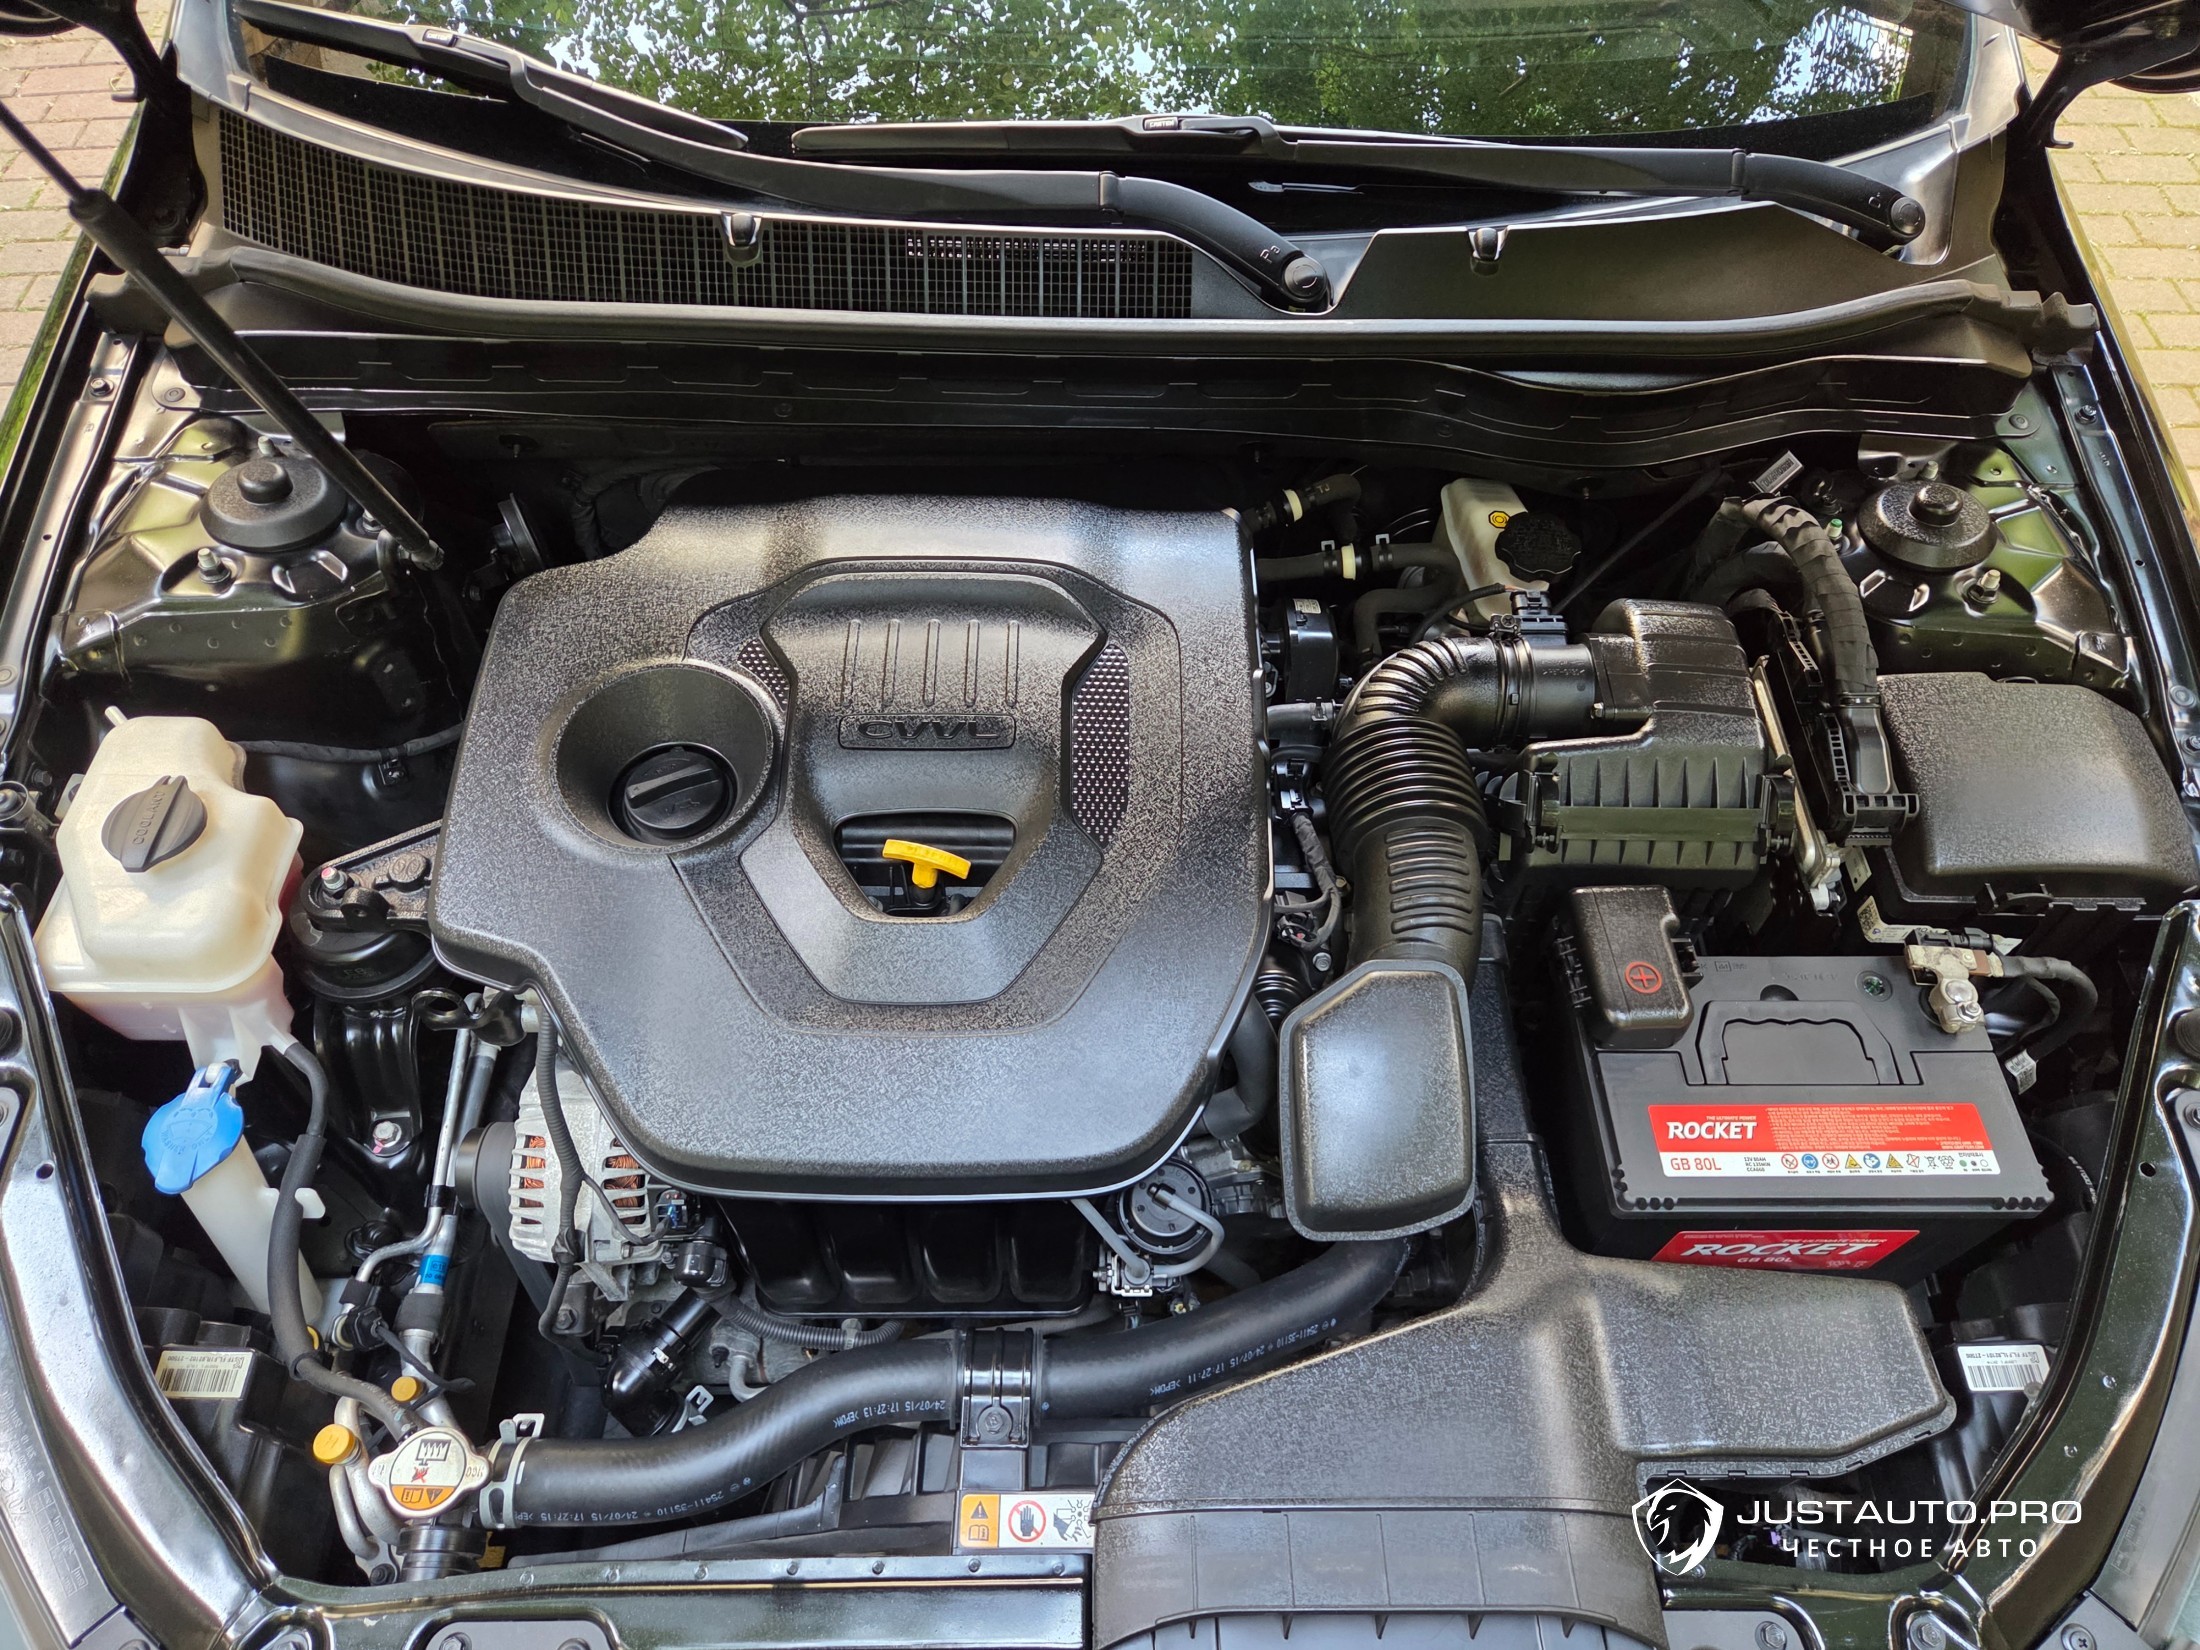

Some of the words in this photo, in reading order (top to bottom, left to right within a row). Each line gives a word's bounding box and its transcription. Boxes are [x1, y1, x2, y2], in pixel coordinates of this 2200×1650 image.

[858, 720, 1000, 740] CVVL
[132, 791, 166, 846] COOLANT
[1666, 1121, 1758, 1140] ROCKET
[1671, 1157, 1691, 1171] GB
[1694, 1157, 1722, 1171] 80L
[1680, 1243, 1880, 1257] ROCKET
[1229, 1345, 1265, 1368] 24/07/15
[1188, 1363, 1226, 1385] 17:27:11
[863, 1402, 899, 1418] 17:27:13
[904, 1400, 946, 1412] 24/07/15
[656, 1490, 724, 1516] 25411-3S110
[540, 1511, 584, 1522] 17:27:15
[591, 1510, 638, 1521] 24/07/15
